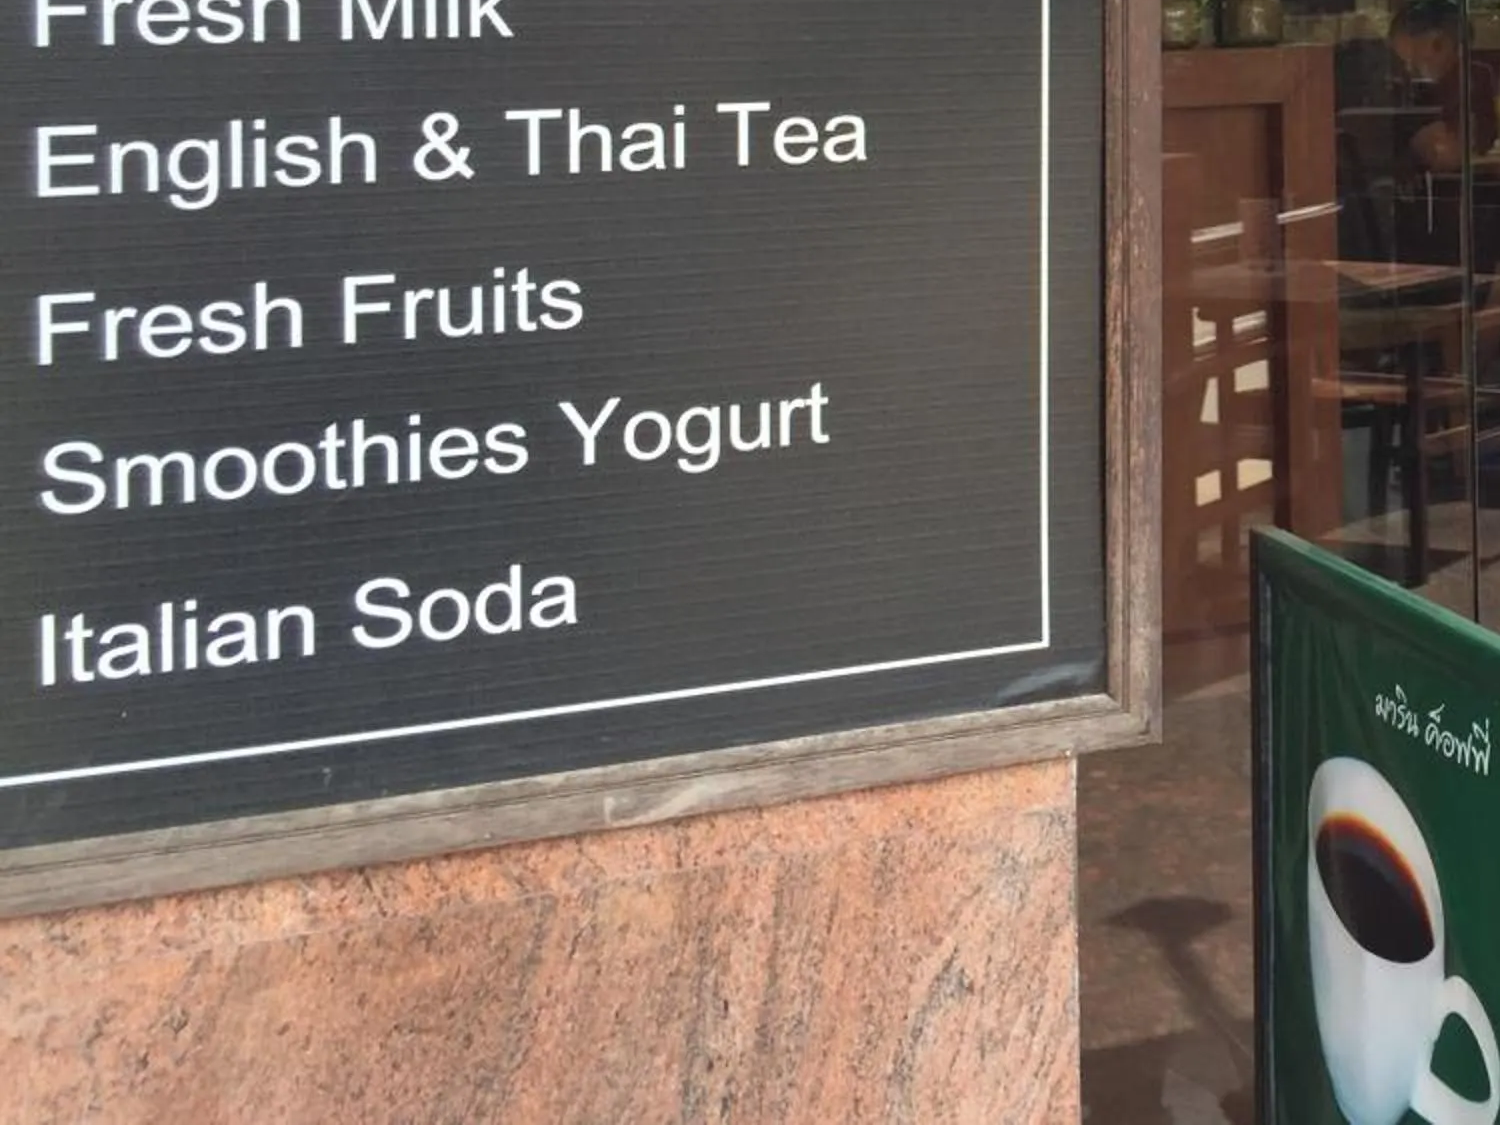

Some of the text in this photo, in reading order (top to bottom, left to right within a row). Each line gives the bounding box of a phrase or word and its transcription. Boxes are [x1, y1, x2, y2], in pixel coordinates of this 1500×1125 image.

[35, 100, 868, 211] English & Thai Tea
[37, 266, 584, 367] Fresh Fruits
[39, 381, 831, 515] Smoothies Yogurt
[40, 563, 578, 687] Italian Soda
